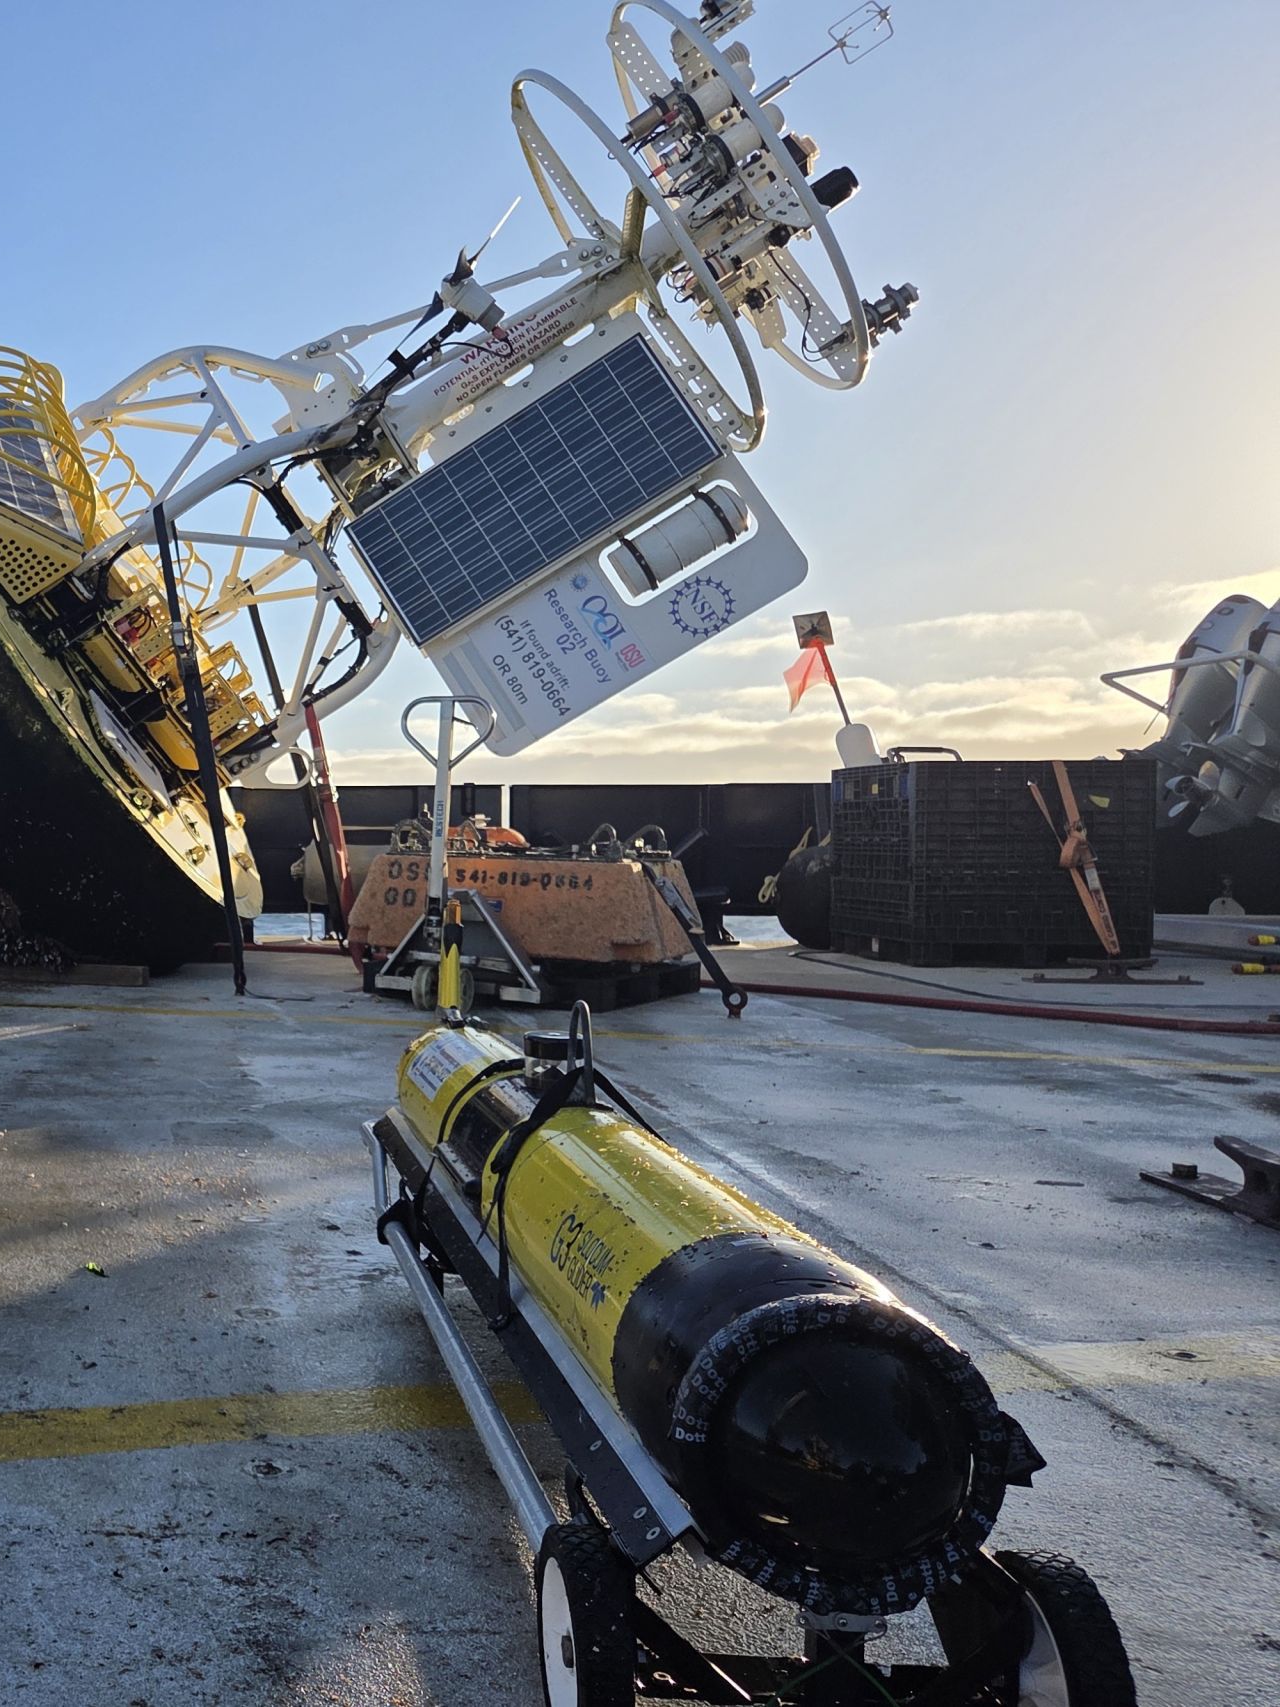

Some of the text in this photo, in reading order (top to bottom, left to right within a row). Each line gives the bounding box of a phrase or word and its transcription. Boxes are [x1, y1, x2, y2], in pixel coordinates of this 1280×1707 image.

[434, 363, 479, 396] POTENTIAL
[525, 296, 578, 338] FLAMMABLE
[460, 313, 537, 365] WARIN
[526, 320, 561, 347] HAZARD
[456, 322, 575, 403] NO OPEN FLAMES OR SPARKS
[685, 588, 720, 623] NSF
[520, 619, 570, 691] If found adrift:
[544, 588, 613, 684] Research Buoy
[556, 633, 576, 655] 02
[620, 643, 646, 668] OSU
[492, 654, 528, 704] OR 80m
[494, 615, 571, 716] (541) 819-0664
